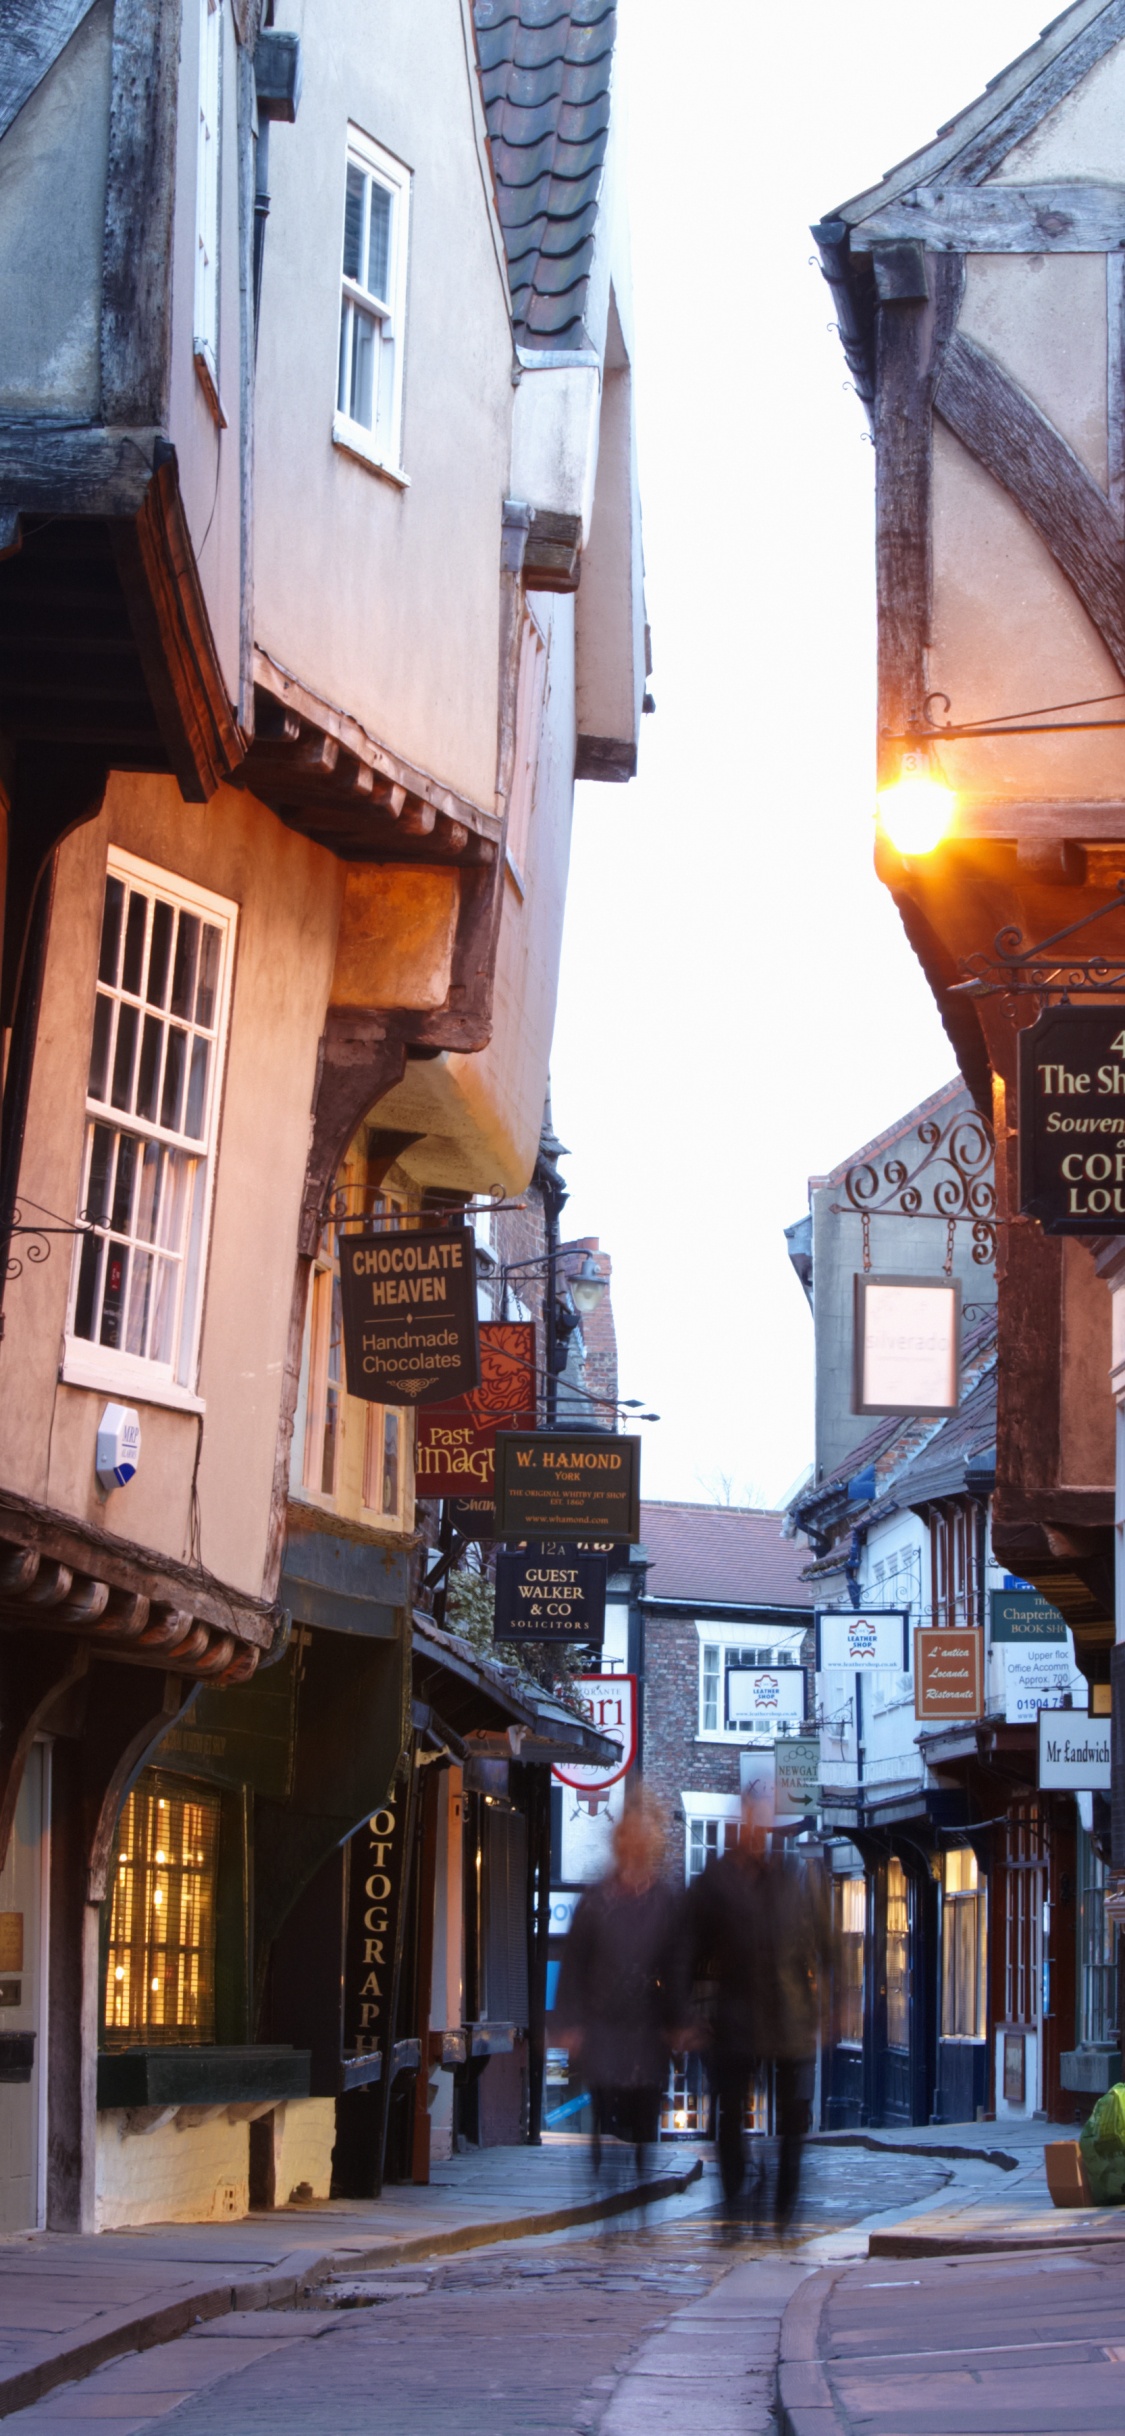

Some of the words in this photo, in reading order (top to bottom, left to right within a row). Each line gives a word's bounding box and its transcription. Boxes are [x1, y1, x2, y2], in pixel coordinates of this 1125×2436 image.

[1110, 1030, 1125, 1058] 4
[1037, 1065, 1091, 1094] The
[352, 1244, 463, 1276] CHOCOLATE
[372, 1276, 447, 1305] HEAVEN
[362, 1328, 459, 1351] Handmade
[362, 1352, 462, 1374] Chocolates
[123, 1425, 139, 1443] MRP
[516, 1449, 537, 1468] W.
[542, 1452, 623, 1470] HAMOND
[554, 1471, 582, 1482] YORK
[508, 1489, 524, 1497] THE
[525, 1490, 560, 1498] ORIGINAL
[562, 1491, 592, 1499] WHITBY
[606, 1492, 628, 1500] SHOP
[524, 1515, 609, 1525] www.whamond.com
[525, 1569, 579, 1583] GUEST
[518, 1586, 585, 1600] WALKER
[530, 1603, 542, 1616] &
[546, 1603, 572, 1616] CO
[510, 1621, 590, 1630] SOLICITORS
[1011, 1624, 1045, 1634] BOOK
[1028, 1652, 1053, 1661] Upper
[928, 1667, 969, 1678] Locanda
[1008, 1664, 1032, 1673] Office
[925, 1688, 974, 1699] Ristorante
[1017, 1698, 1049, 1710] 01904
[1046, 1740, 1061, 1763] Mr
